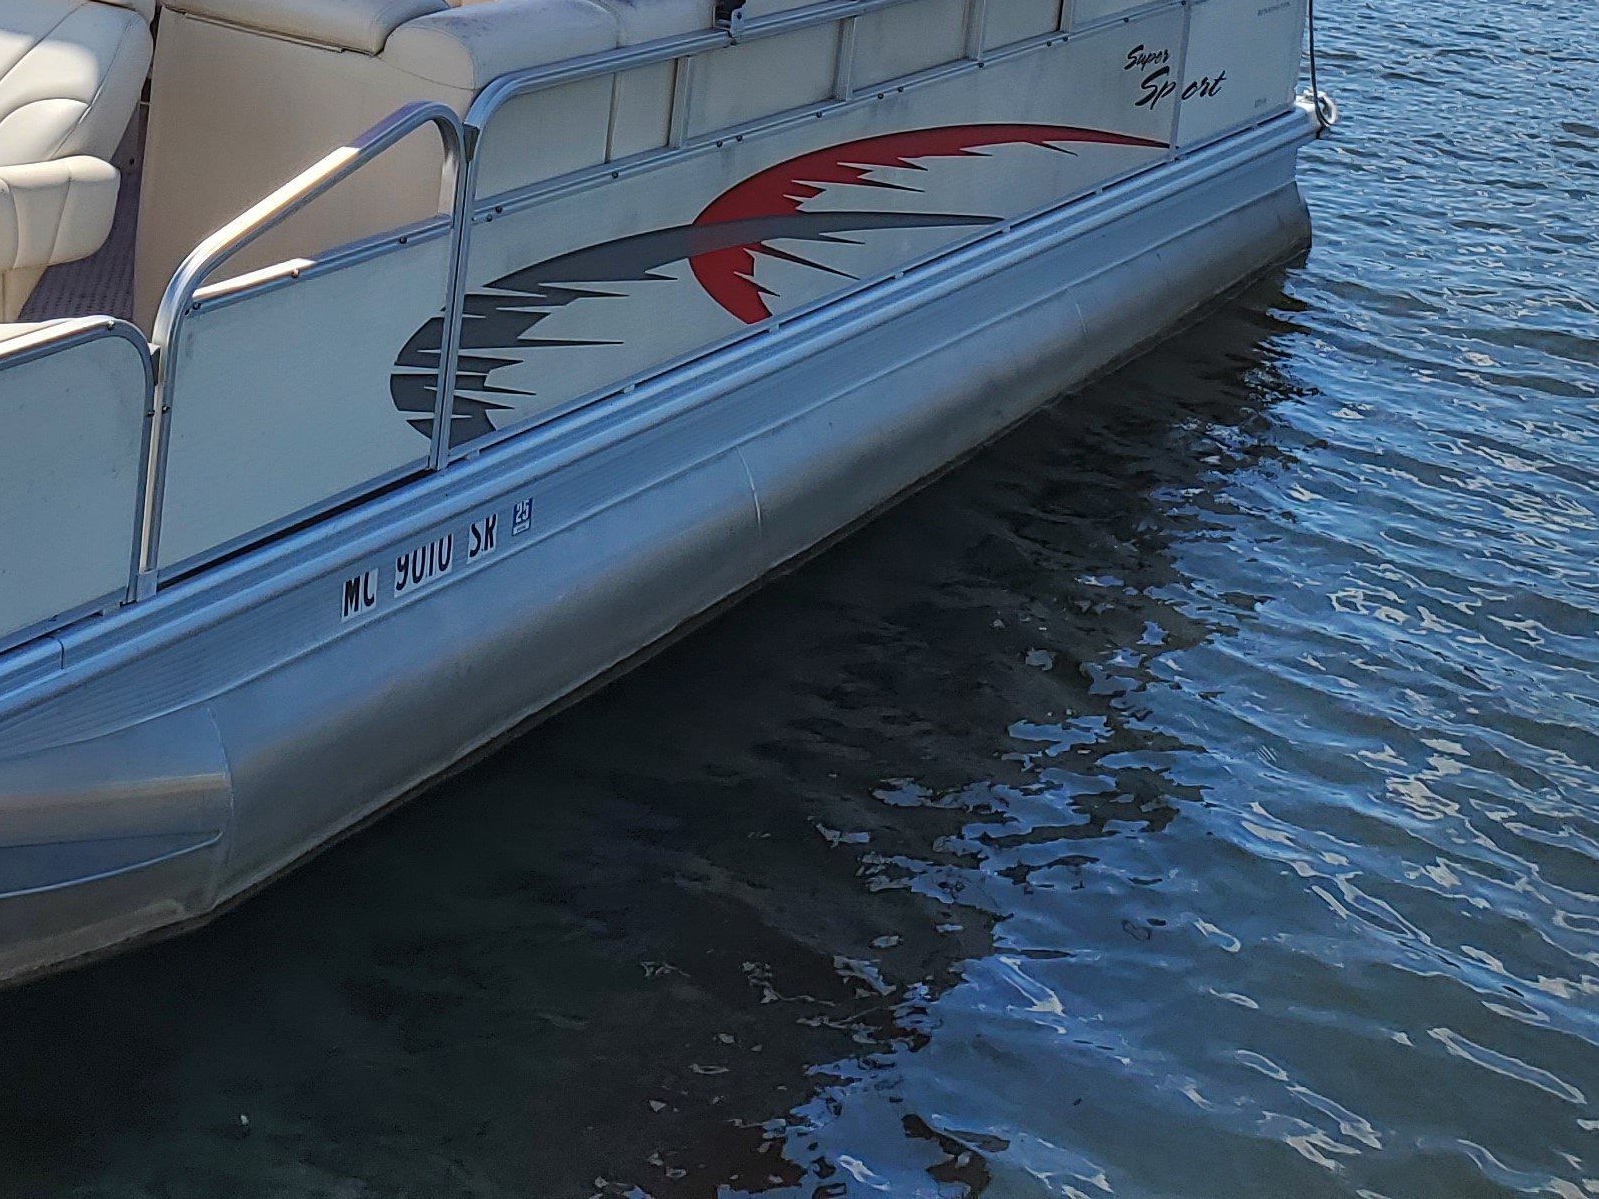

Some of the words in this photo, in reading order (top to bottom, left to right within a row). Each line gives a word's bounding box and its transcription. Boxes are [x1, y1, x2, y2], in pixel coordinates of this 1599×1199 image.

[1123, 44, 1171, 71] Super
[1135, 66, 1227, 110] Sport
[515, 499, 530, 523] 25
[343, 571, 375, 618] MC
